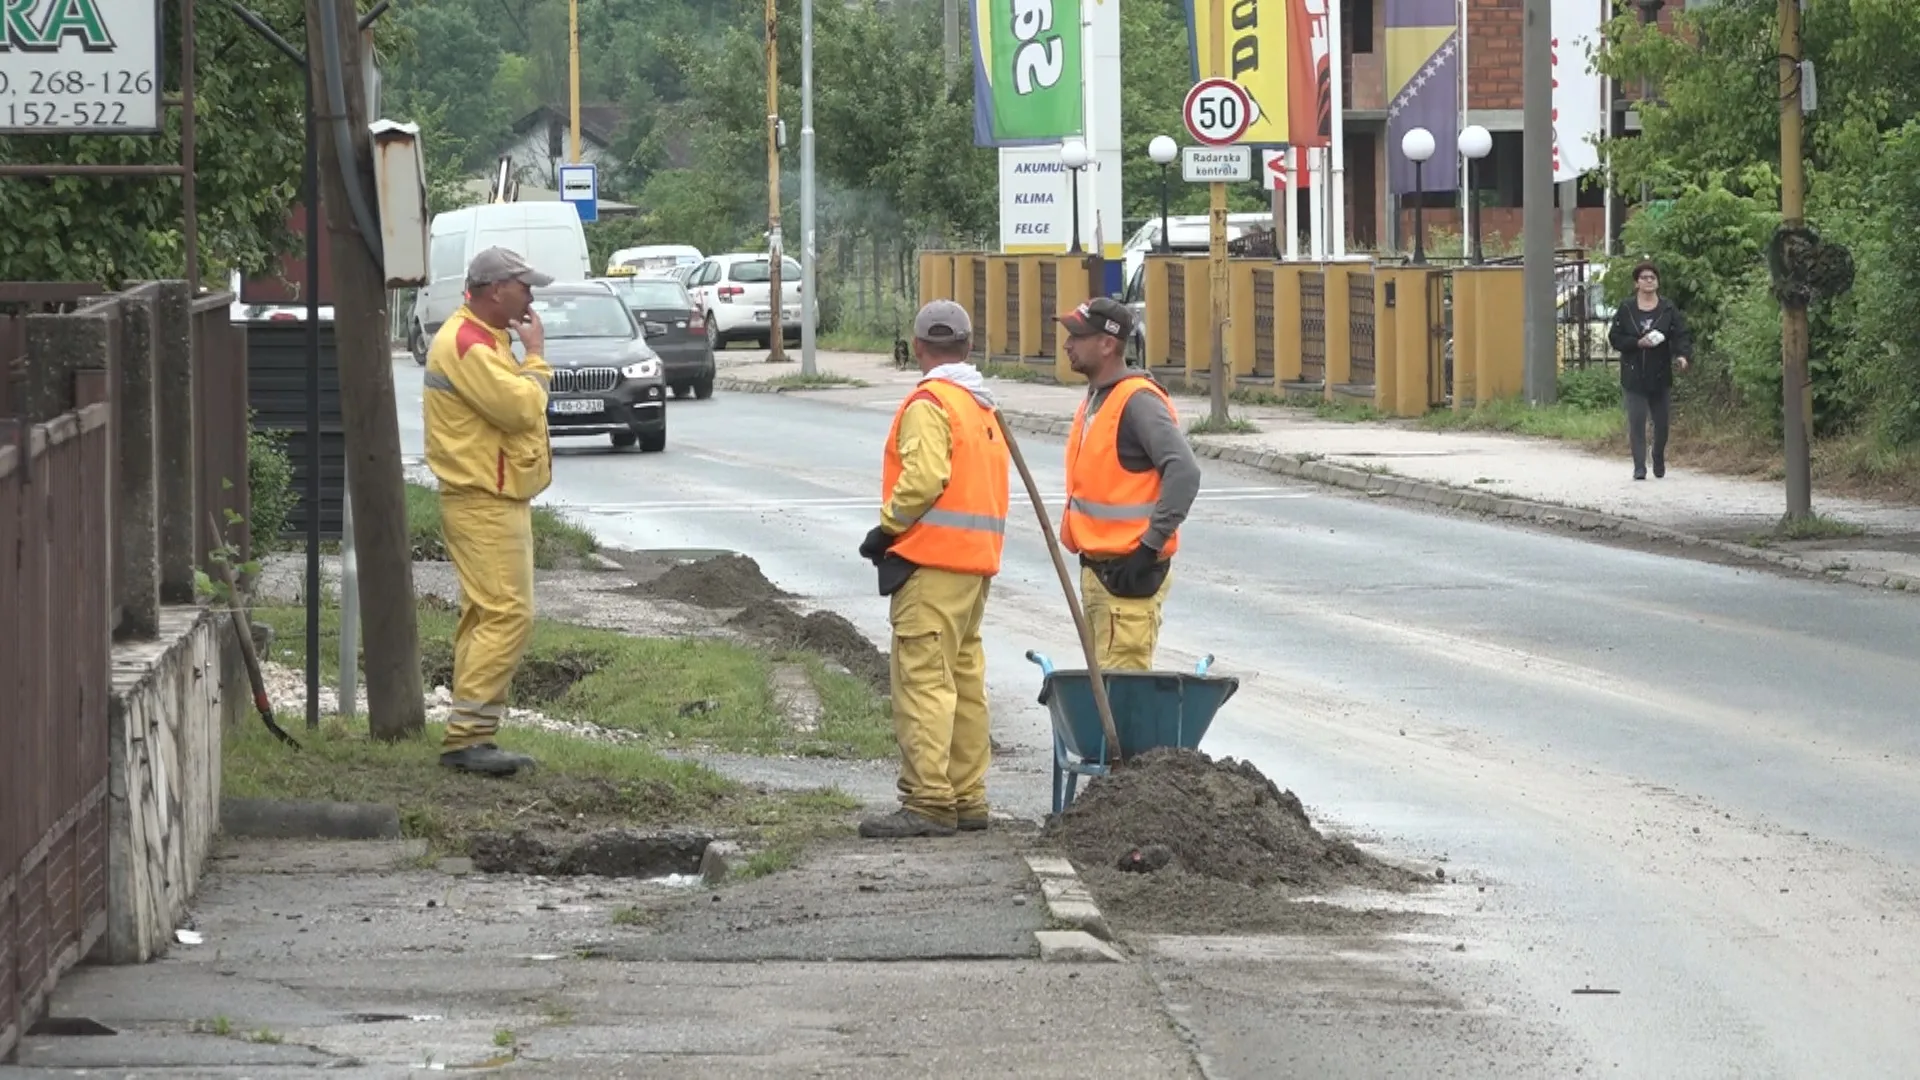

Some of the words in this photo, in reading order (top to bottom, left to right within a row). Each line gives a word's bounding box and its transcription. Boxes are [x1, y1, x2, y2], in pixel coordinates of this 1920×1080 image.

[29, 70, 153, 95] 268-126
[8, 101, 127, 126] 152-522
[1200, 97, 1236, 129] 50
[1193, 153, 1240, 162] Radarska
[1196, 166, 1238, 176] kontrola
[1015, 193, 1054, 204] KLIMA
[1015, 223, 1050, 234] FELGE
